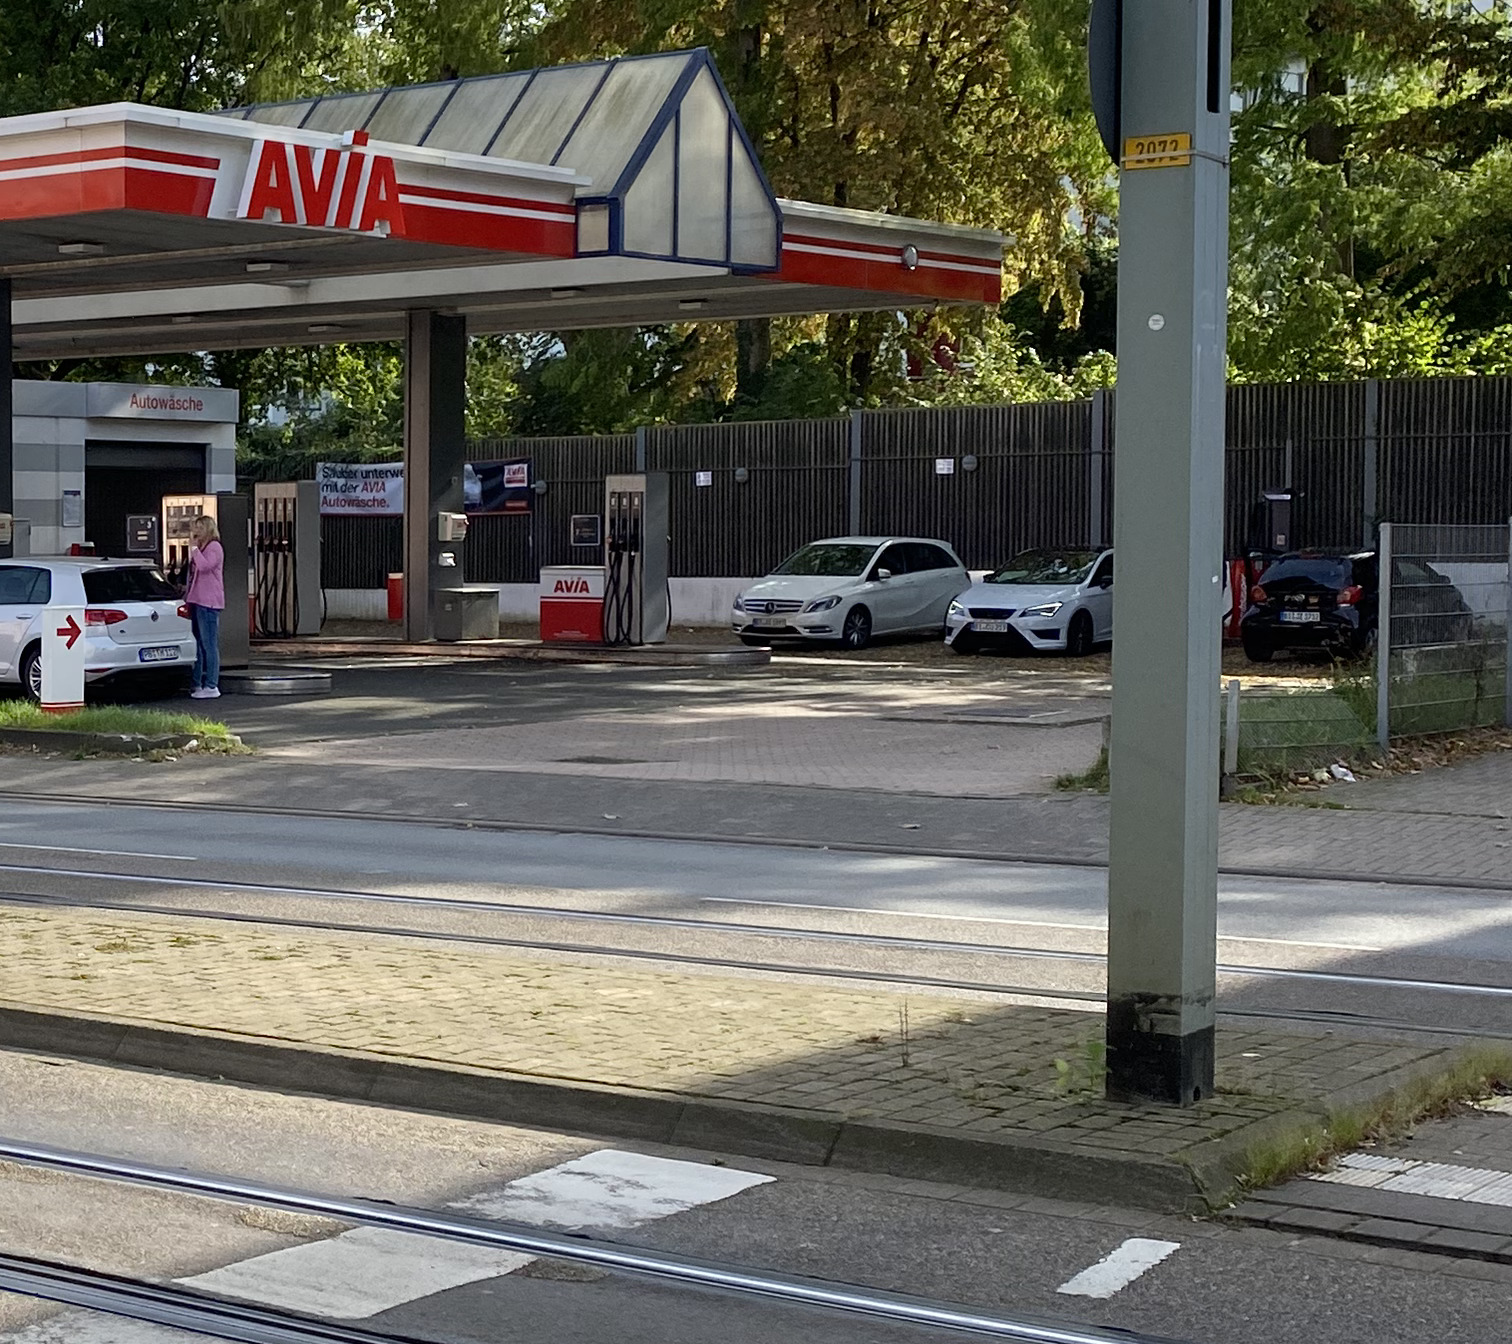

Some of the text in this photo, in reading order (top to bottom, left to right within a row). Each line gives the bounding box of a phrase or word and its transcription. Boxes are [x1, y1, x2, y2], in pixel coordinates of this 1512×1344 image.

[1135, 139, 1179, 164] 2072
[246, 130, 406, 235] AVIA
[130, 392, 204, 412] Autowäsche
[321, 481, 386, 494] mit der AVIA
[554, 577, 590, 593] AVIA
